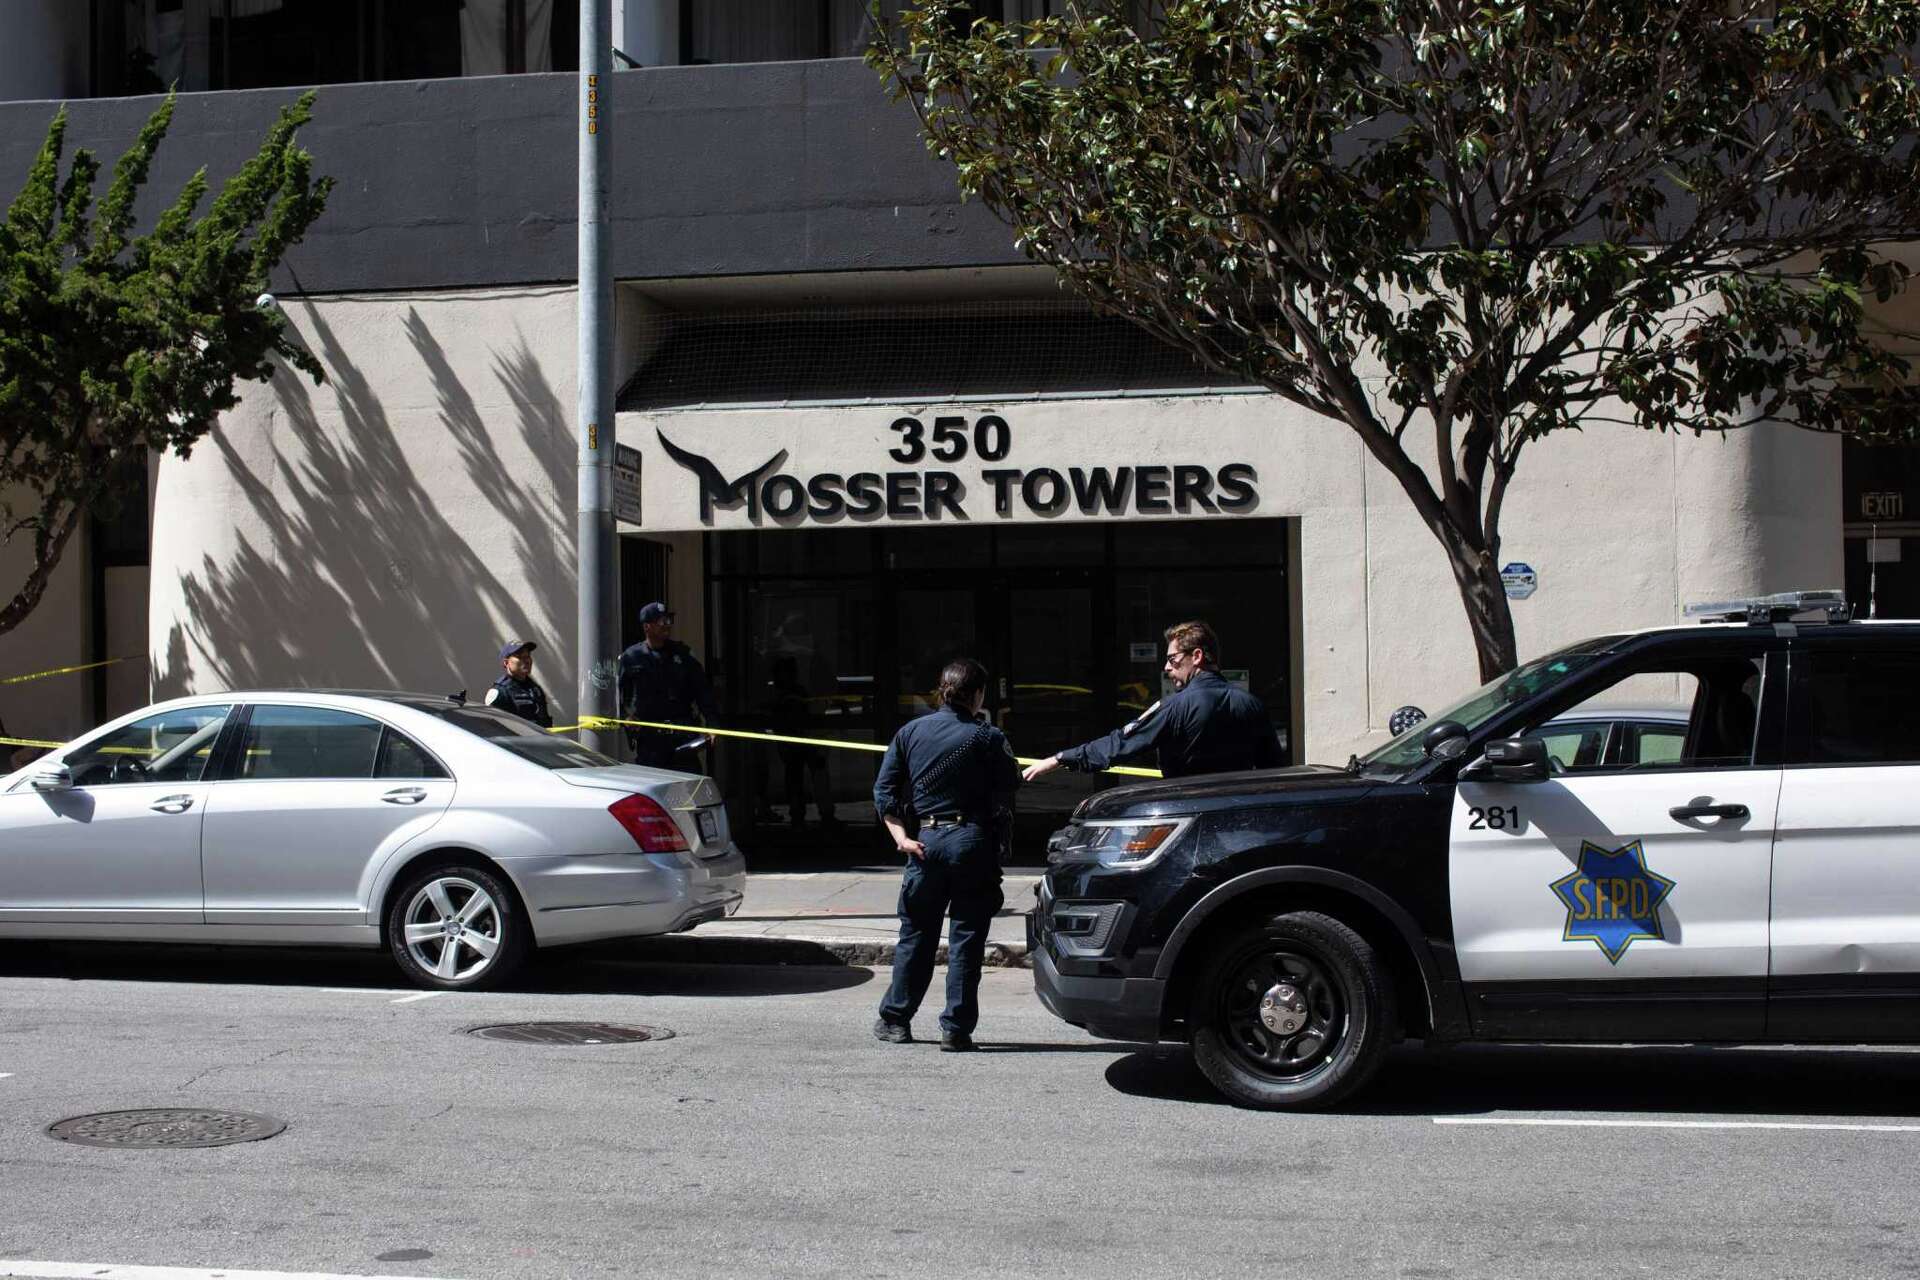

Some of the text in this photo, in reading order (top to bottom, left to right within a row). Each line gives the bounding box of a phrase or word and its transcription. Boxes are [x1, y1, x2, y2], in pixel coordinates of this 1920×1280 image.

[888, 415, 1011, 464] 350
[656, 426, 971, 526] MOSSER
[981, 463, 1260, 519] TOWERS
[1863, 495, 1898, 516] EXIT
[1468, 805, 1519, 830] 281
